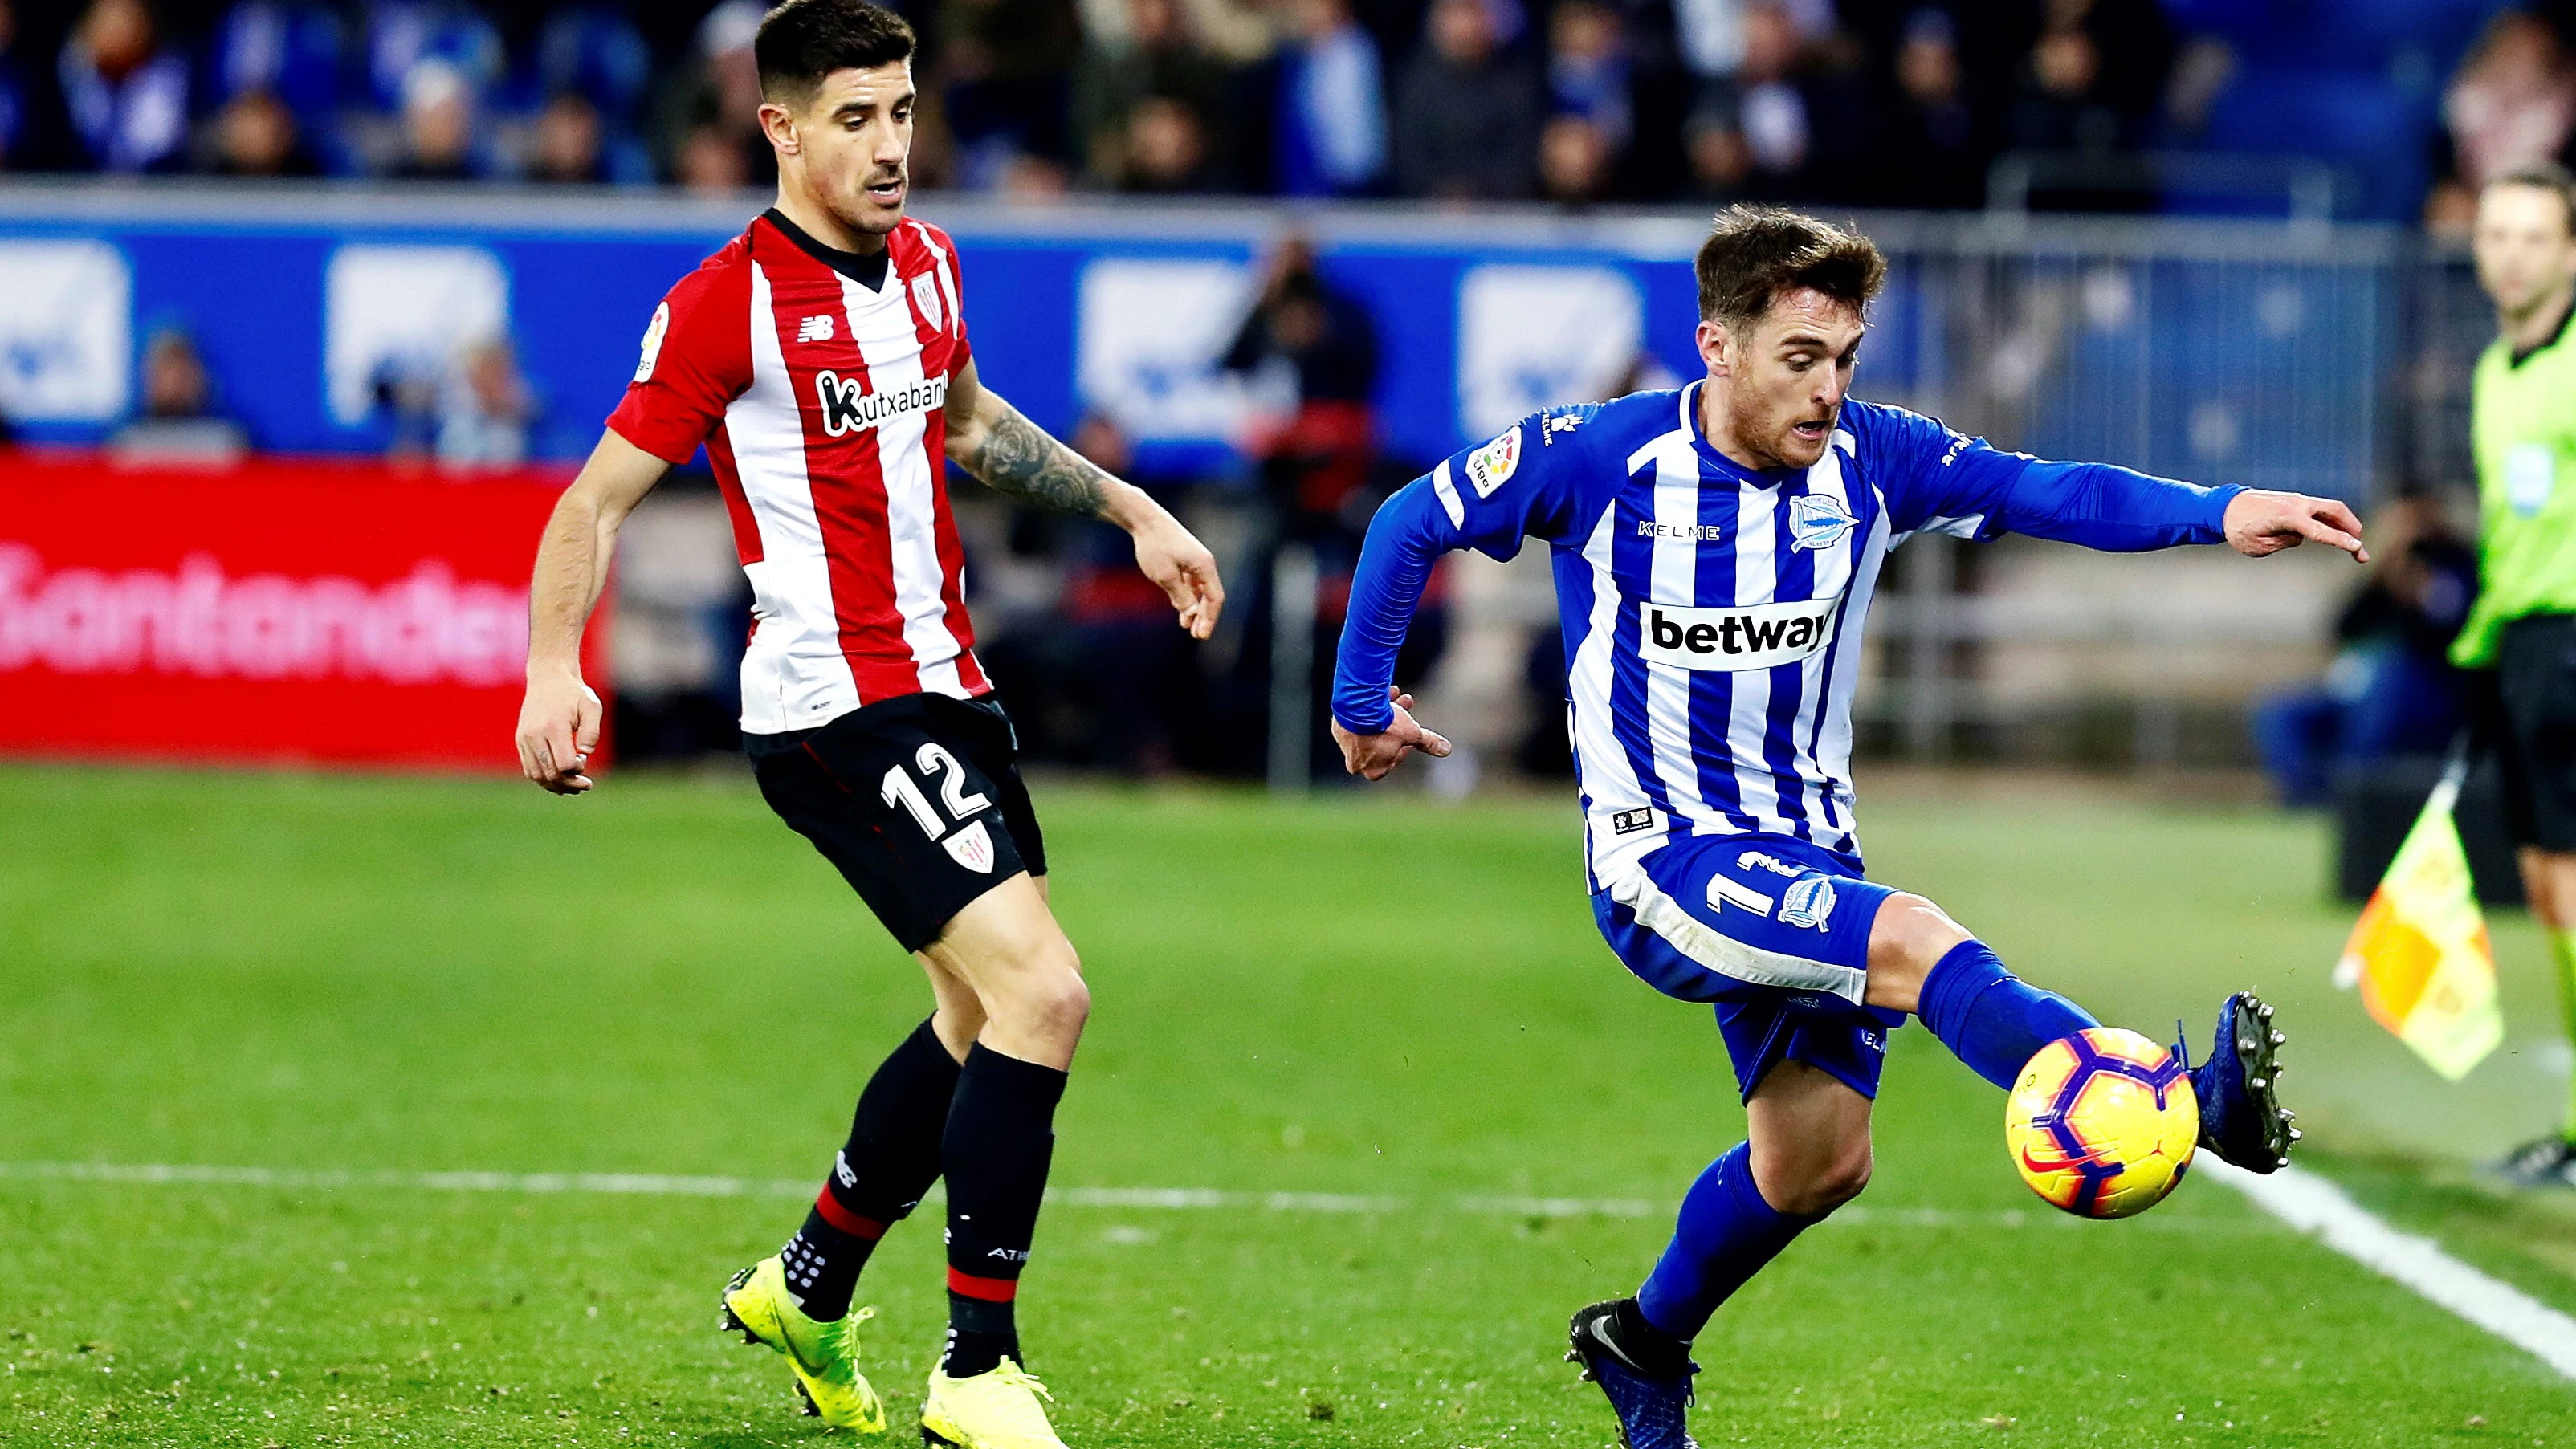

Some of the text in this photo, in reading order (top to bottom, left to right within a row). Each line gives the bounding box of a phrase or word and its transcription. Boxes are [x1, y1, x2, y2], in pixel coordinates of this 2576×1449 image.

[1638, 520, 1720, 541] KELME
[1651, 604, 1836, 655] betway
[881, 743, 992, 841] 12
